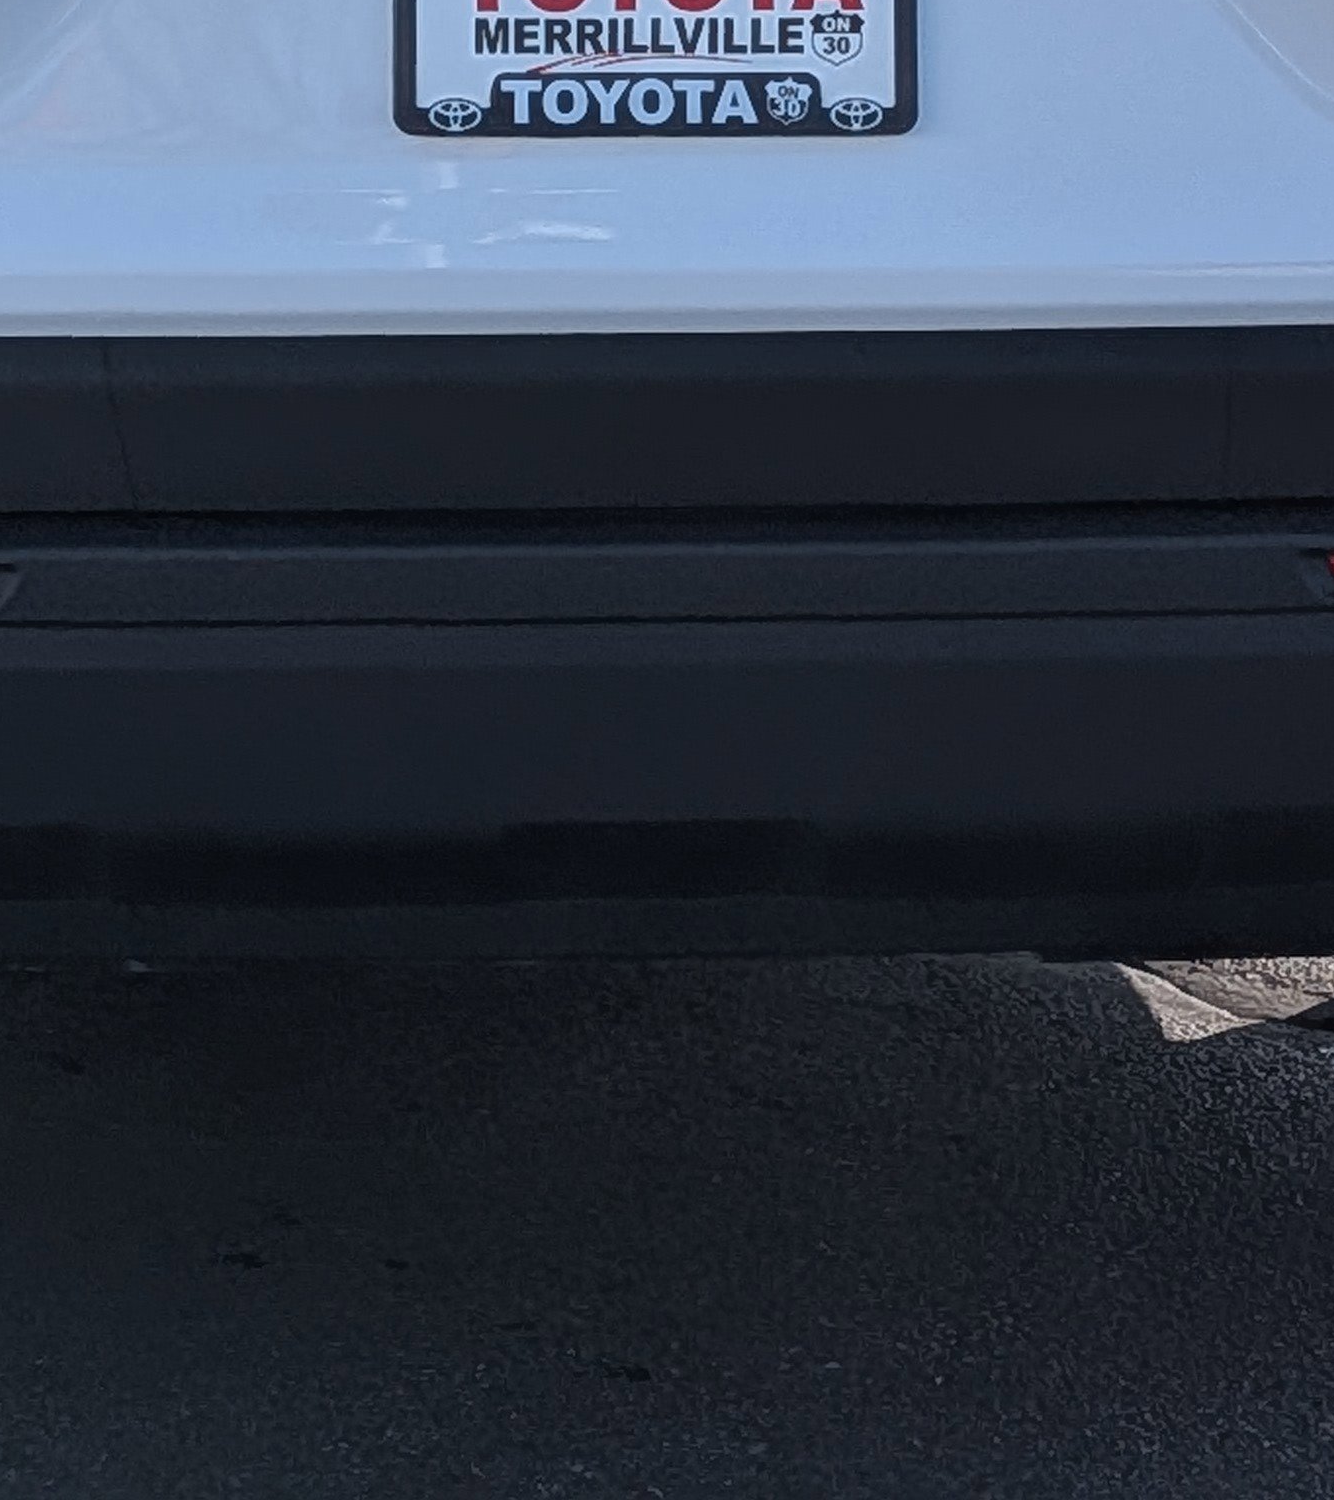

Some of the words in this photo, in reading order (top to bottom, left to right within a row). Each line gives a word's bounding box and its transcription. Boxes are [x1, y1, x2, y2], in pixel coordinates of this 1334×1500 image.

[821, 17, 851, 32] ON
[474, 17, 805, 54] MERRILLVILLE
[822, 36, 852, 55] 30
[501, 79, 758, 125] TOYOTA
[770, 98, 803, 118] 30
